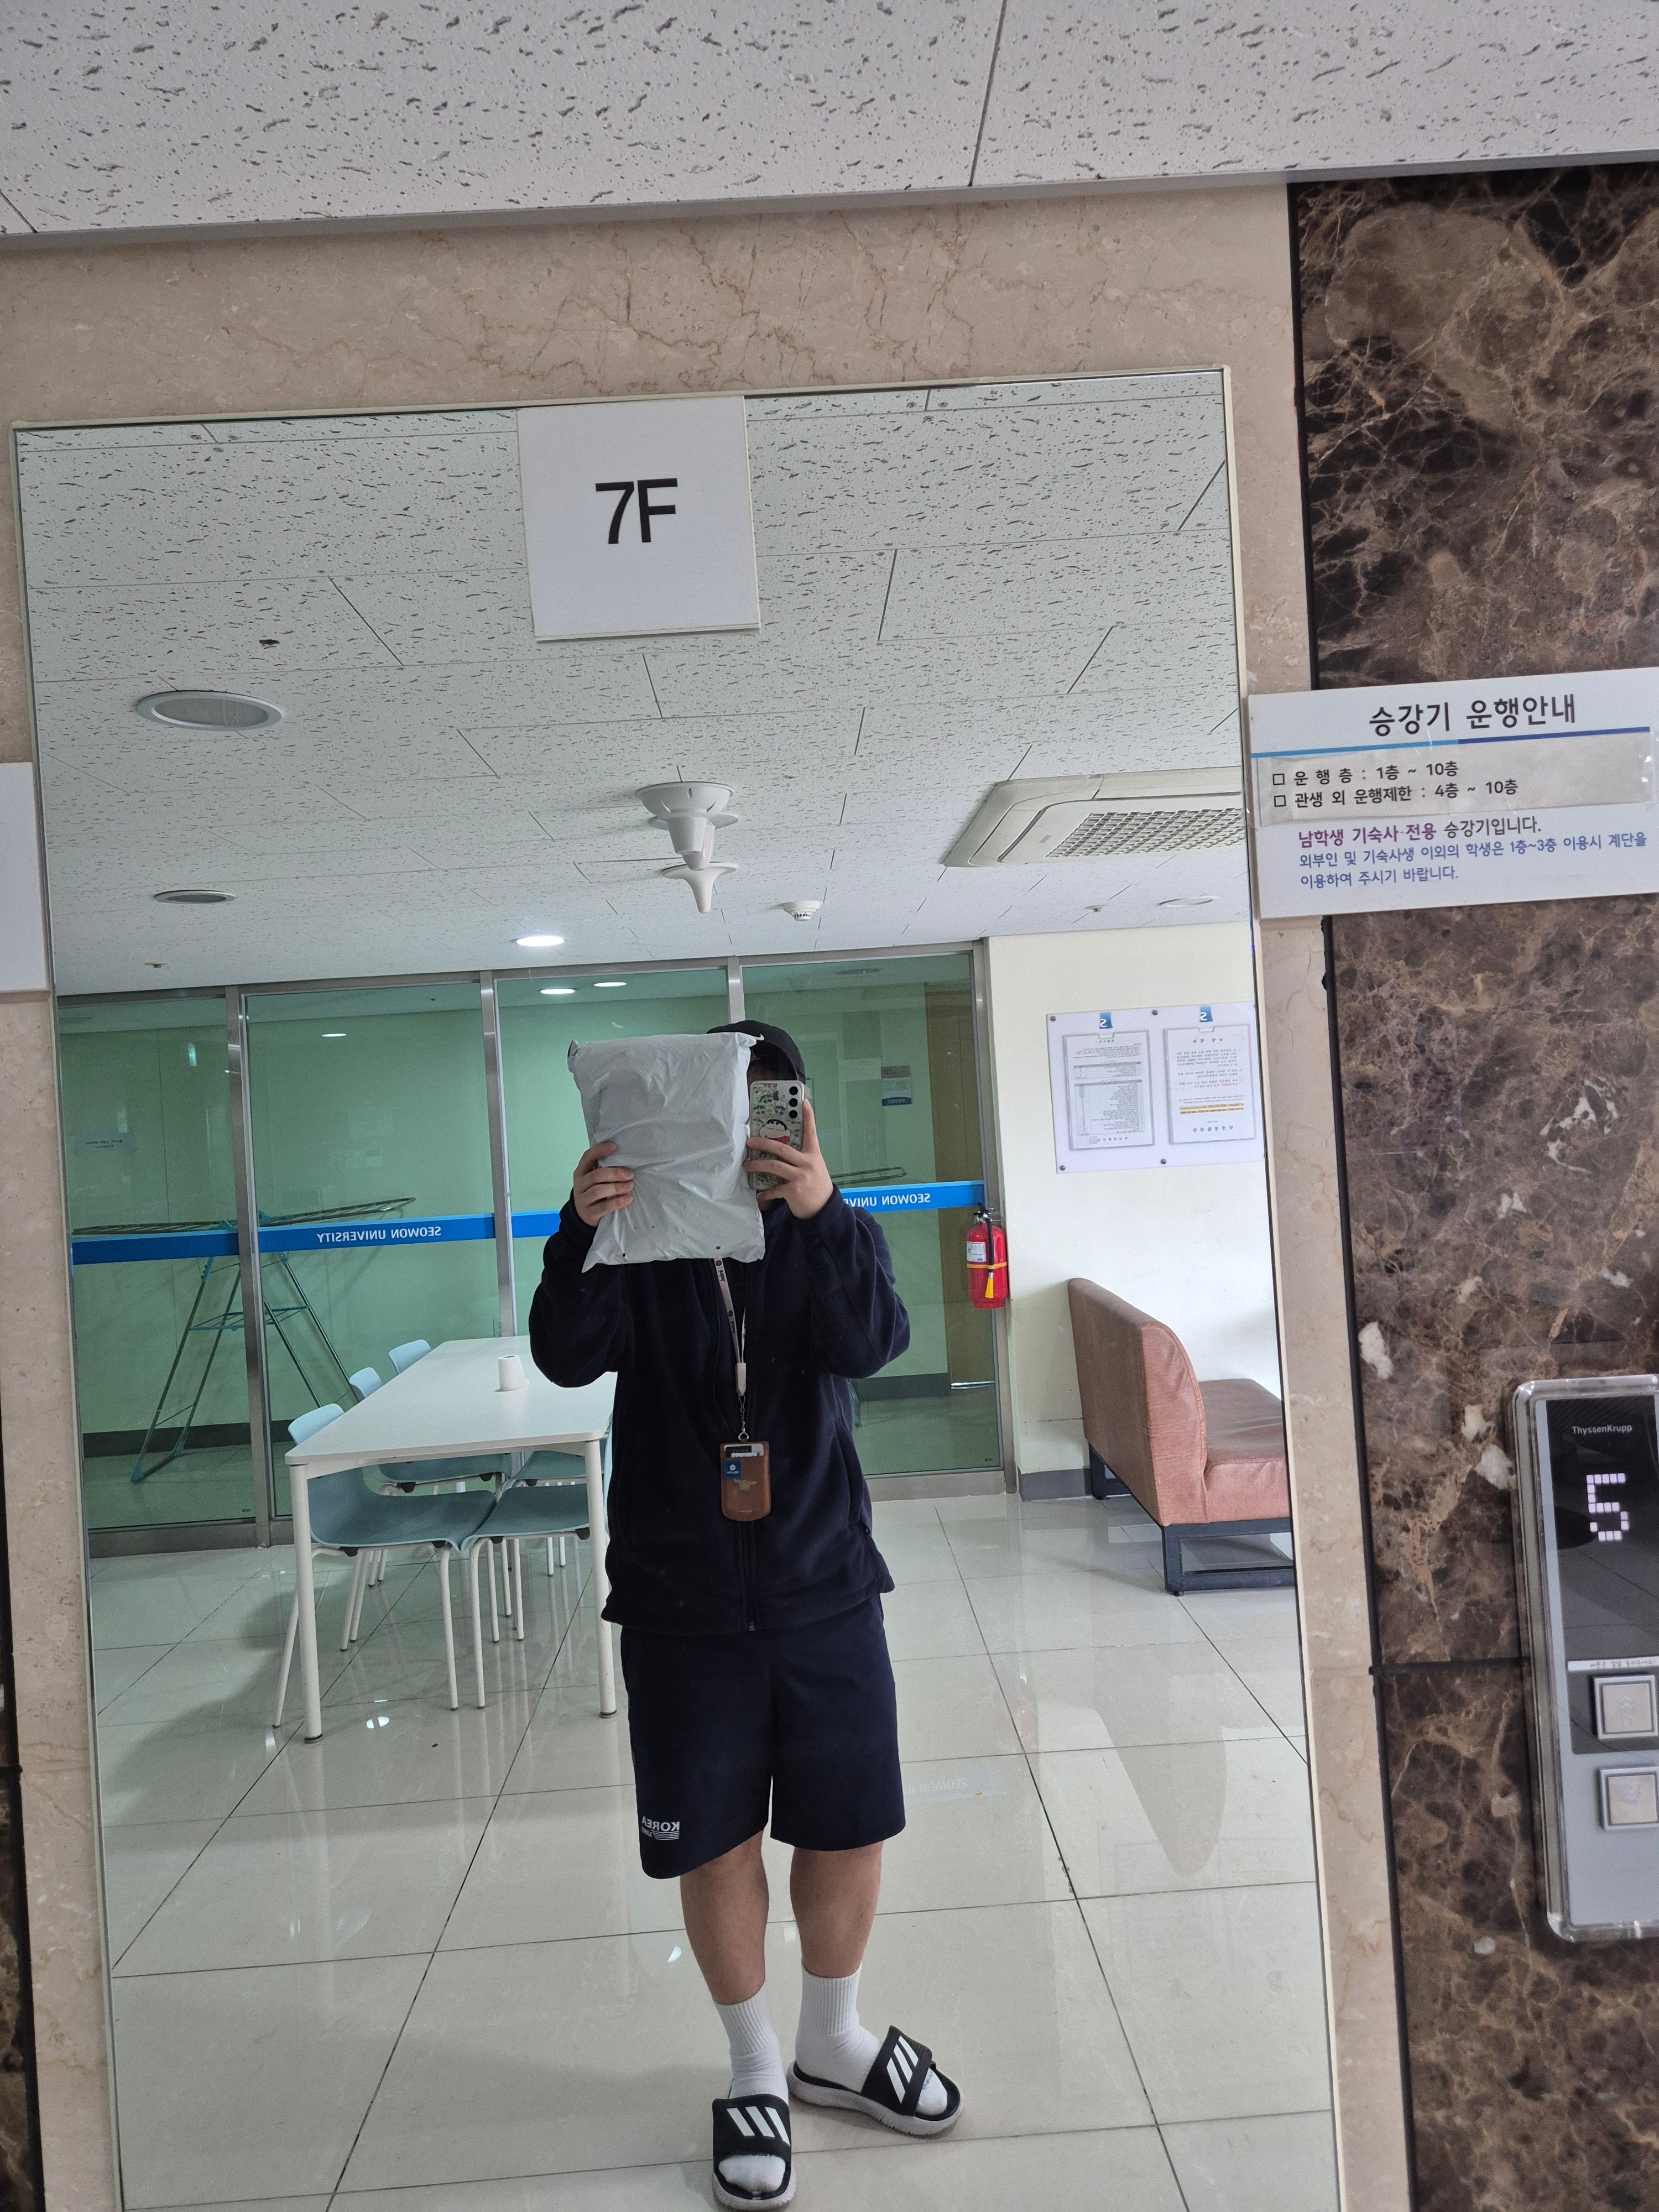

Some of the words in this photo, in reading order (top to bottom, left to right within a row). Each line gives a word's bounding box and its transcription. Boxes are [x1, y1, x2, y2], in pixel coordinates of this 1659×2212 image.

[595, 478, 678, 544] 7F
[1369, 702, 1451, 737] 승강기
[1466, 693, 1575, 729] 운행안내
[1293, 771, 1308, 785] 운
[1316, 769, 1330, 785] 행
[1338, 768, 1353, 784] 층
[1375, 765, 1400, 780] 1층
[1426, 761, 1459, 776] 10층
[1294, 793, 1323, 808] 관생
[1331, 790, 1345, 806] 외
[1354, 786, 1412, 804] 운행제한
[1434, 782, 1459, 799] 4층
[1485, 779, 1518, 795] 10층
[1298, 829, 1344, 848] 남학생
[1352, 825, 1399, 844] 기숙사
[1406, 822, 1437, 841] 전용
[1444, 815, 1541, 838] 승강기입니다.
[1300, 852, 1338, 868] 외부인
[1344, 851, 1357, 865] 및
[1363, 847, 1414, 864] 기숙사생
[1421, 844, 1459, 860] 이외의
[1465, 841, 1504, 857] 학생은
[1510, 837, 1557, 854] 1층~3층
[1563, 834, 1601, 851] 이용시
[1608, 832, 1647, 848] 계단을
[1301, 872, 1352, 889] 이용하여
[1358, 869, 1397, 886] 주시기
[1403, 865, 1459, 882] 바랍니다.
[1572, 1424, 1632, 1436] ThyssenKrupp
[1586, 1473, 1629, 1543] 5
